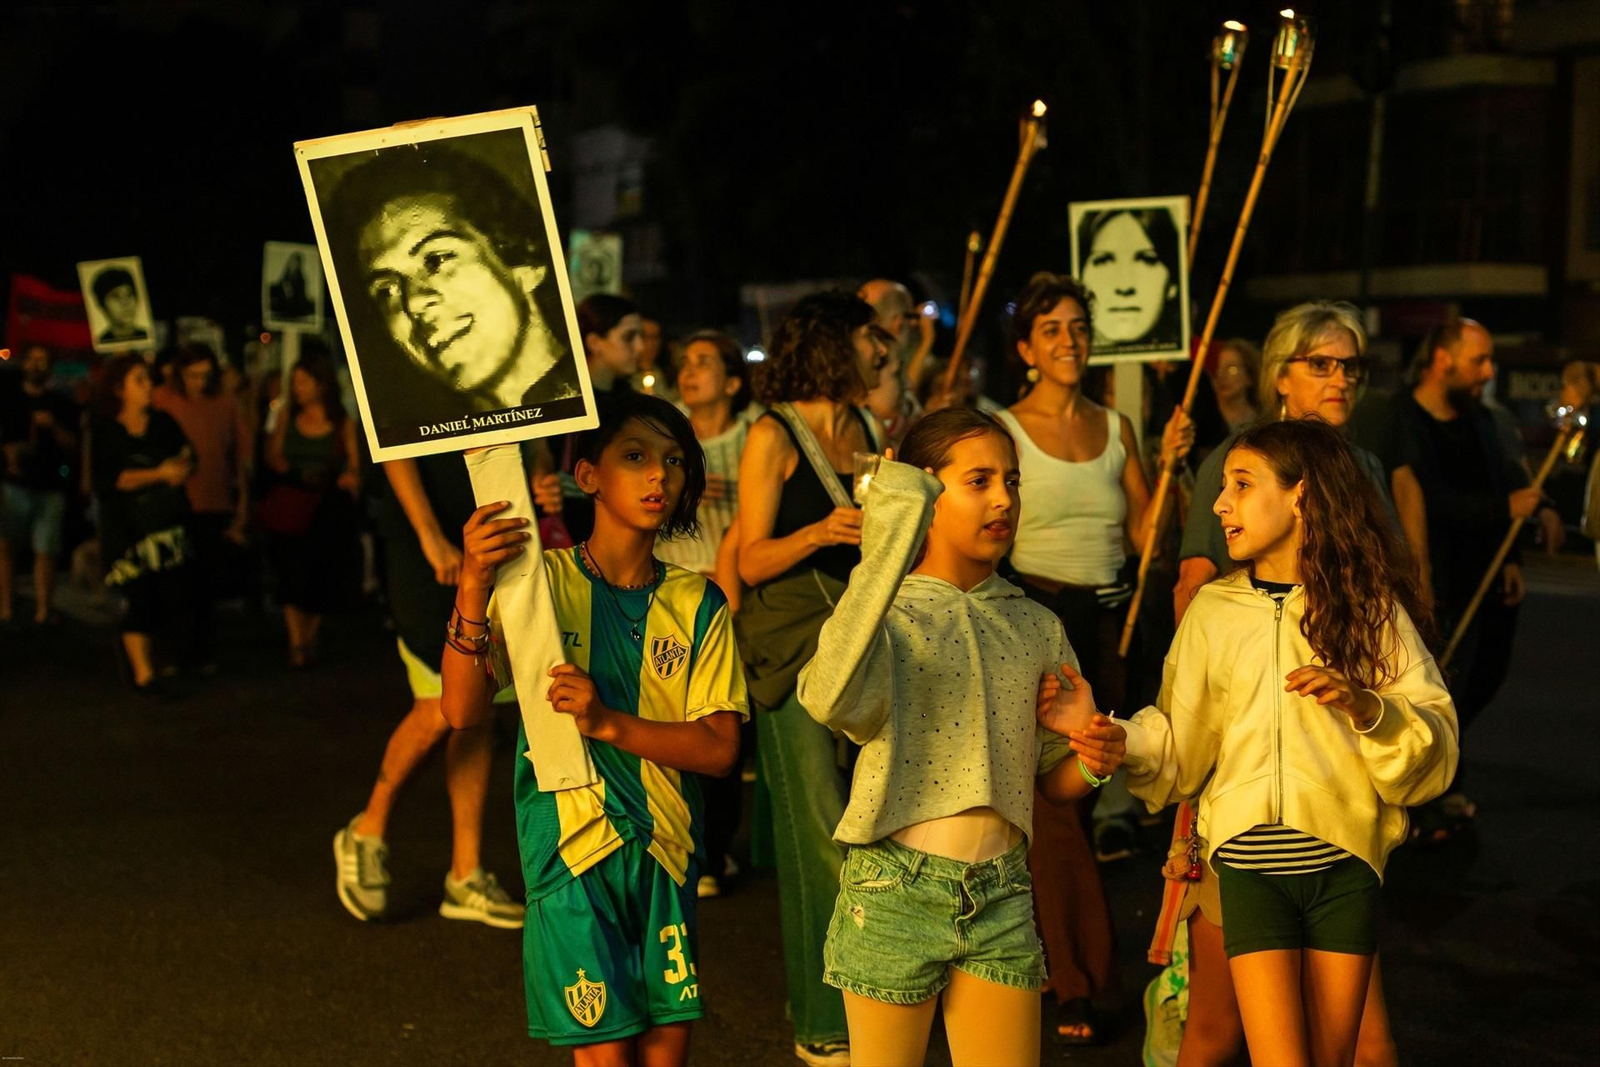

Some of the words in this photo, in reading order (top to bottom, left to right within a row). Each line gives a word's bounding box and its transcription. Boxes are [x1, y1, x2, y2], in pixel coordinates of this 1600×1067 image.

[419, 419, 471, 436] DANIEL
[471, 407, 543, 428] MARTÍNEZ
[562, 631, 582, 647] TL
[654, 646, 685, 667] ATLANTA
[660, 921, 698, 985] 3
[574, 987, 601, 1016] ATLANTA
[680, 984, 699, 1001] AT
